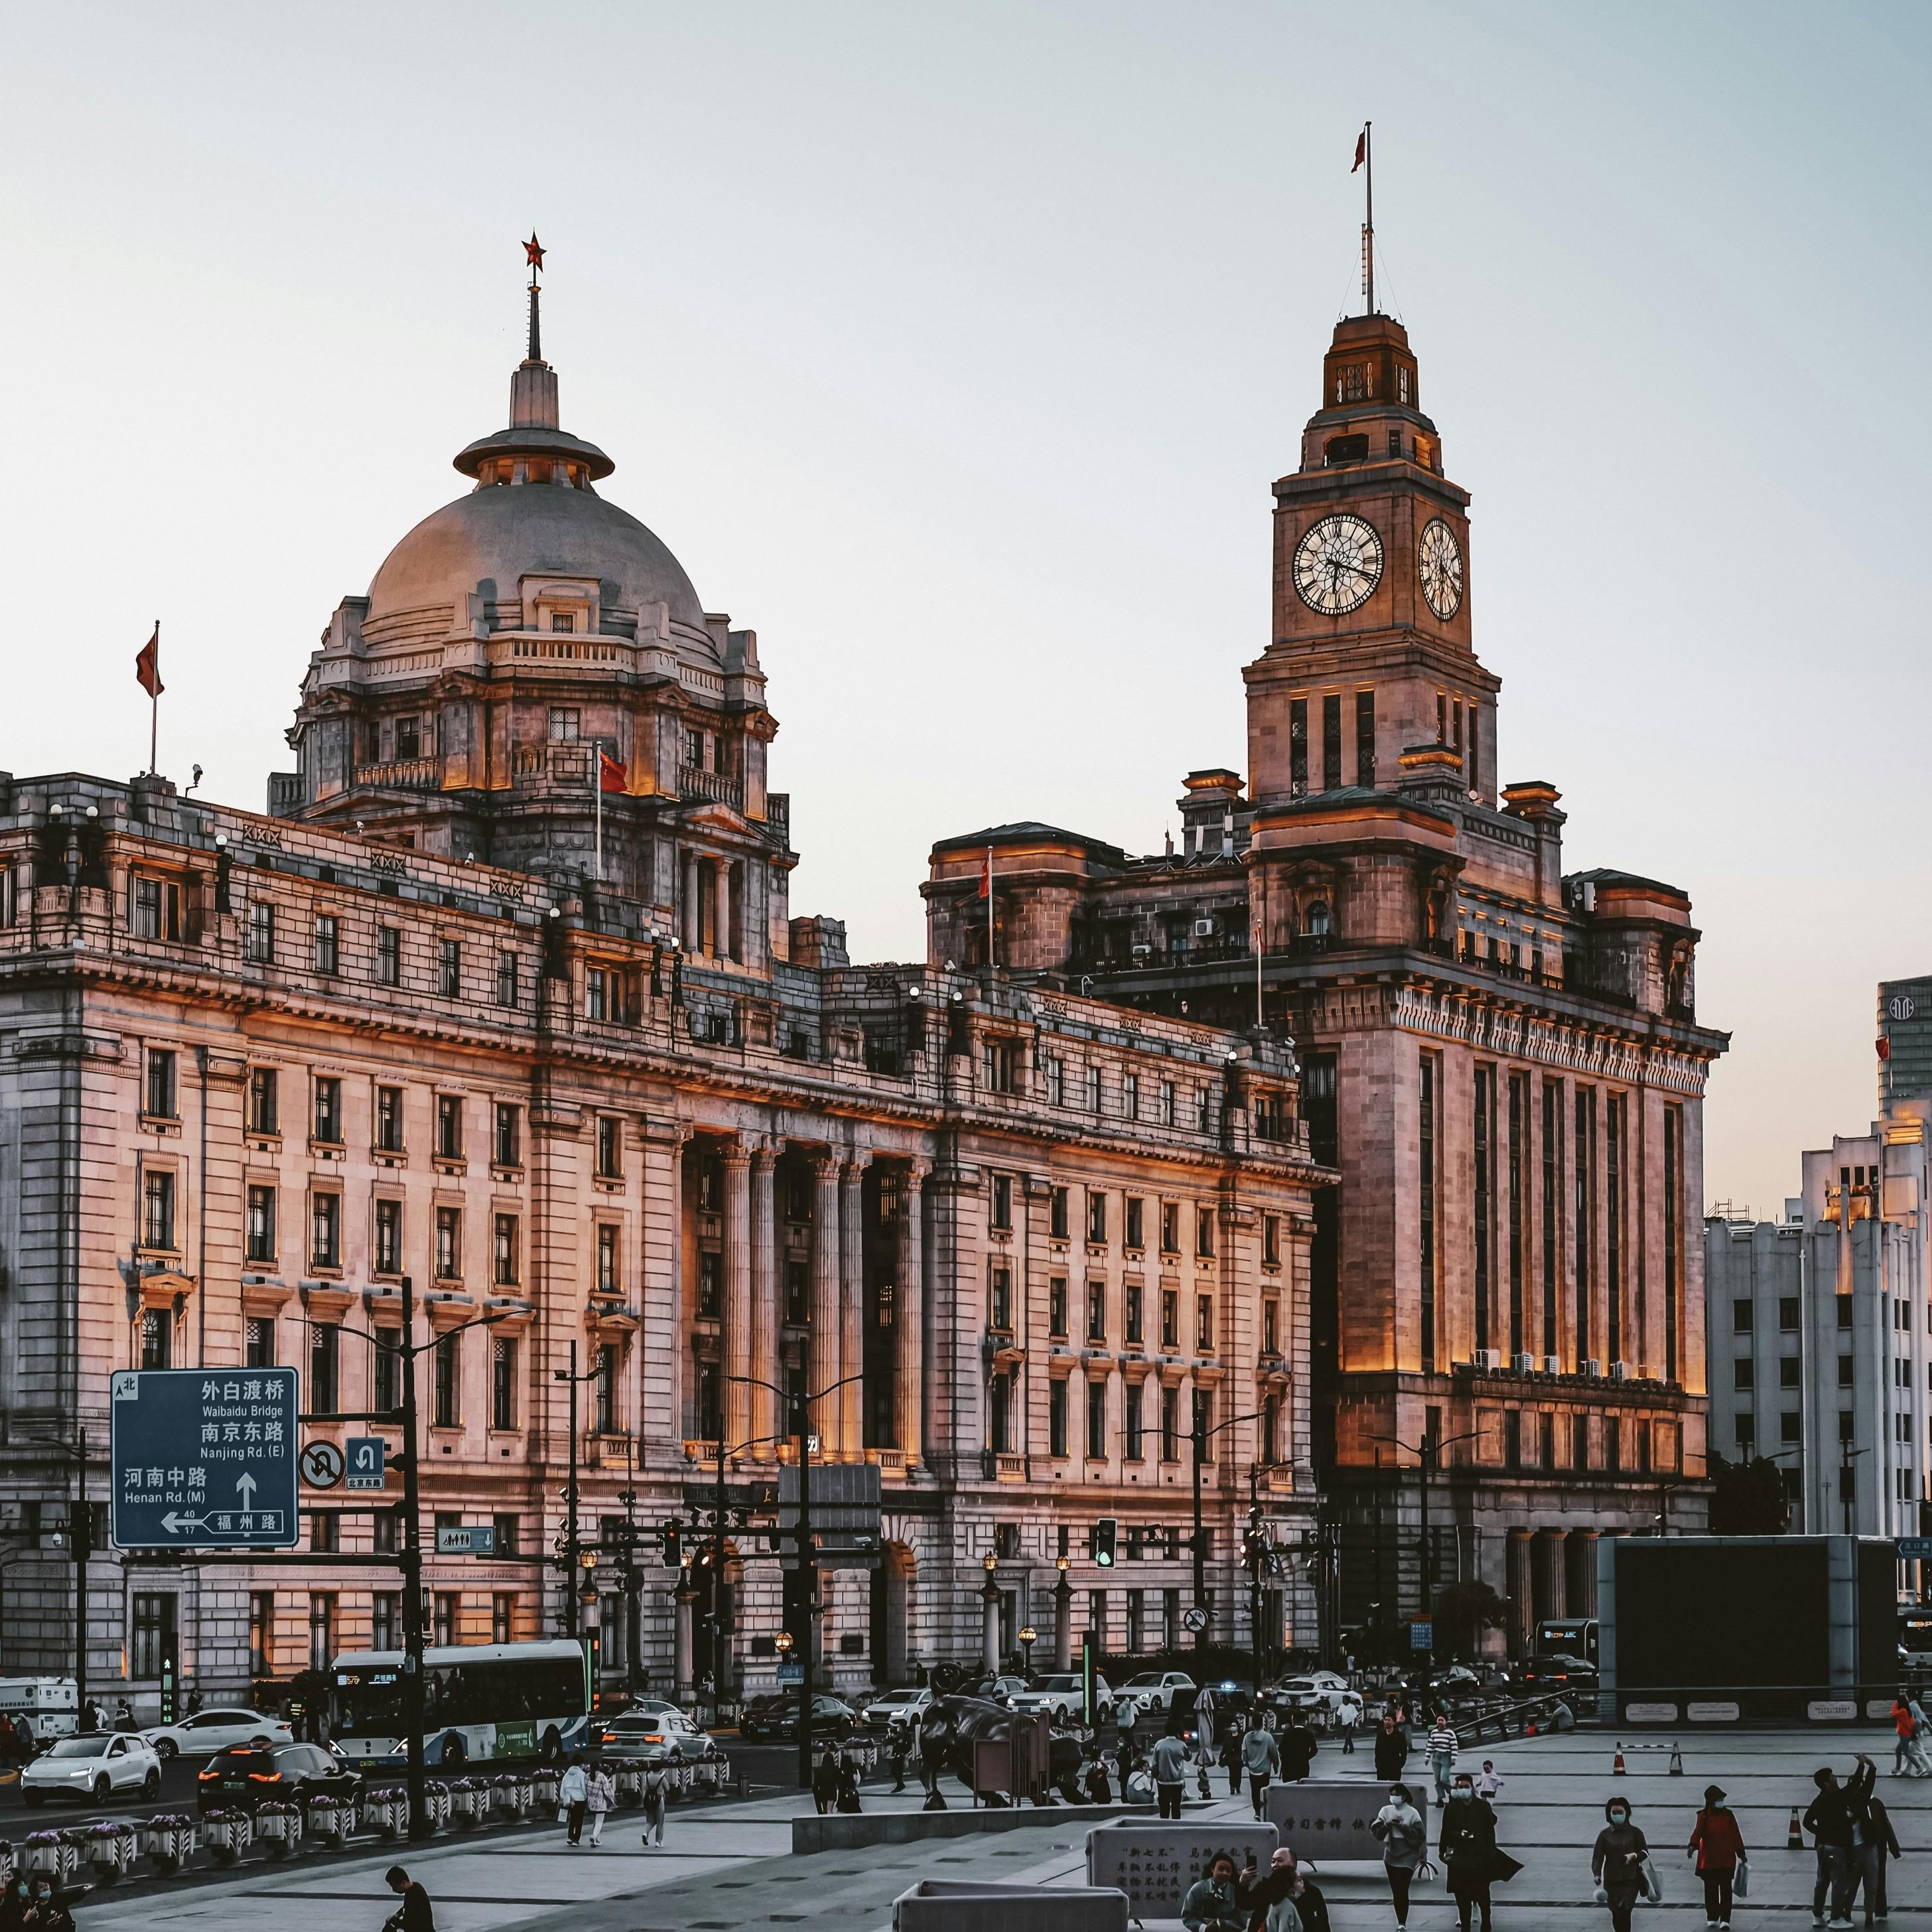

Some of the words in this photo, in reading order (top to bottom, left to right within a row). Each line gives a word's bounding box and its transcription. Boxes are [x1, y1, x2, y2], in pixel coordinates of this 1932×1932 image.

[123, 1377, 135, 1391] 北
[201, 1379, 285, 1401] 外白渡桥
[202, 1405, 247, 1417] Waibaidu
[251, 1405, 283, 1418] Bridge
[200, 1420, 284, 1443] 南京东路
[200, 1447, 244, 1460] Nanjing
[124, 1466, 208, 1487] 河南中路
[125, 1492, 162, 1503] Henan
[184, 1510, 195, 1519] 40
[217, 1514, 275, 1530] 福州路
[1190, 1846, 1253, 1858] 马路乱穿
